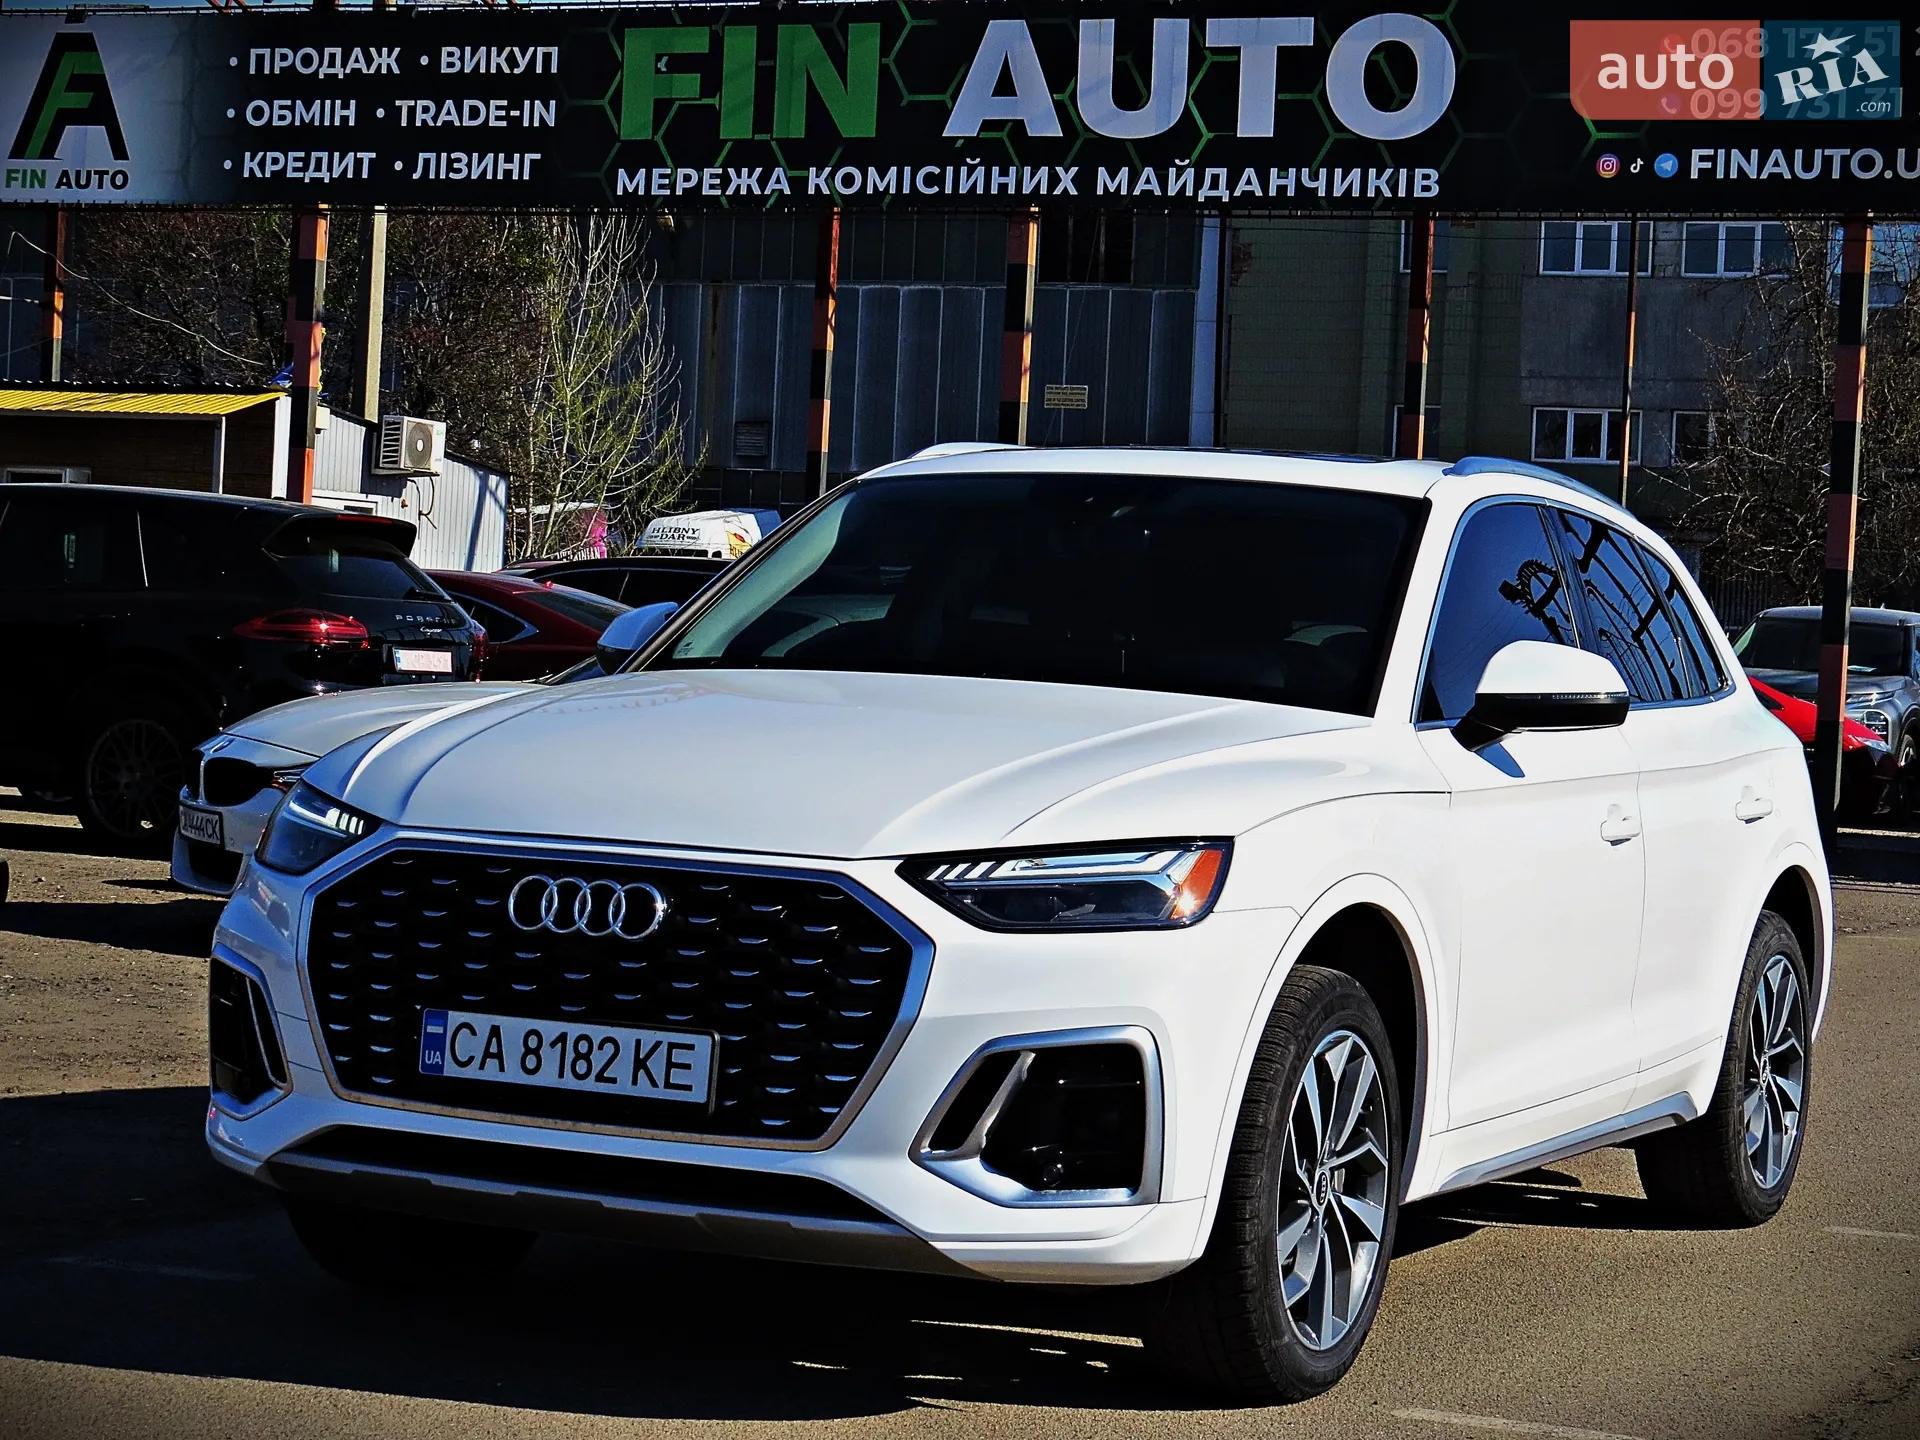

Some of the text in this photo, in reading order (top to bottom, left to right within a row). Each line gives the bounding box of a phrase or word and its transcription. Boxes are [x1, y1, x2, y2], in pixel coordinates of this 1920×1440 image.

[248, 47, 401, 79] ПРОДАЖ
[440, 46, 559, 75] ВИКУП
[618, 12, 1457, 141] FIN AUTO
[245, 100, 356, 127] ОБМІН
[395, 100, 557, 128] TRADE-IN
[4, 168, 130, 190] FIN AUTO
[242, 152, 376, 183] КРЕДИТ
[413, 153, 541, 181] ЛІЗИНГ
[616, 158, 1440, 202] МЕРЕЖА КОМІСІЙНИХ МАЙДАНЧИКІВ
[651, 527, 699, 535] HLIBNY
[659, 533, 686, 542] DAR
[425, 1050, 442, 1065] UA
[450, 1021, 696, 1092] CA 8182 KE
